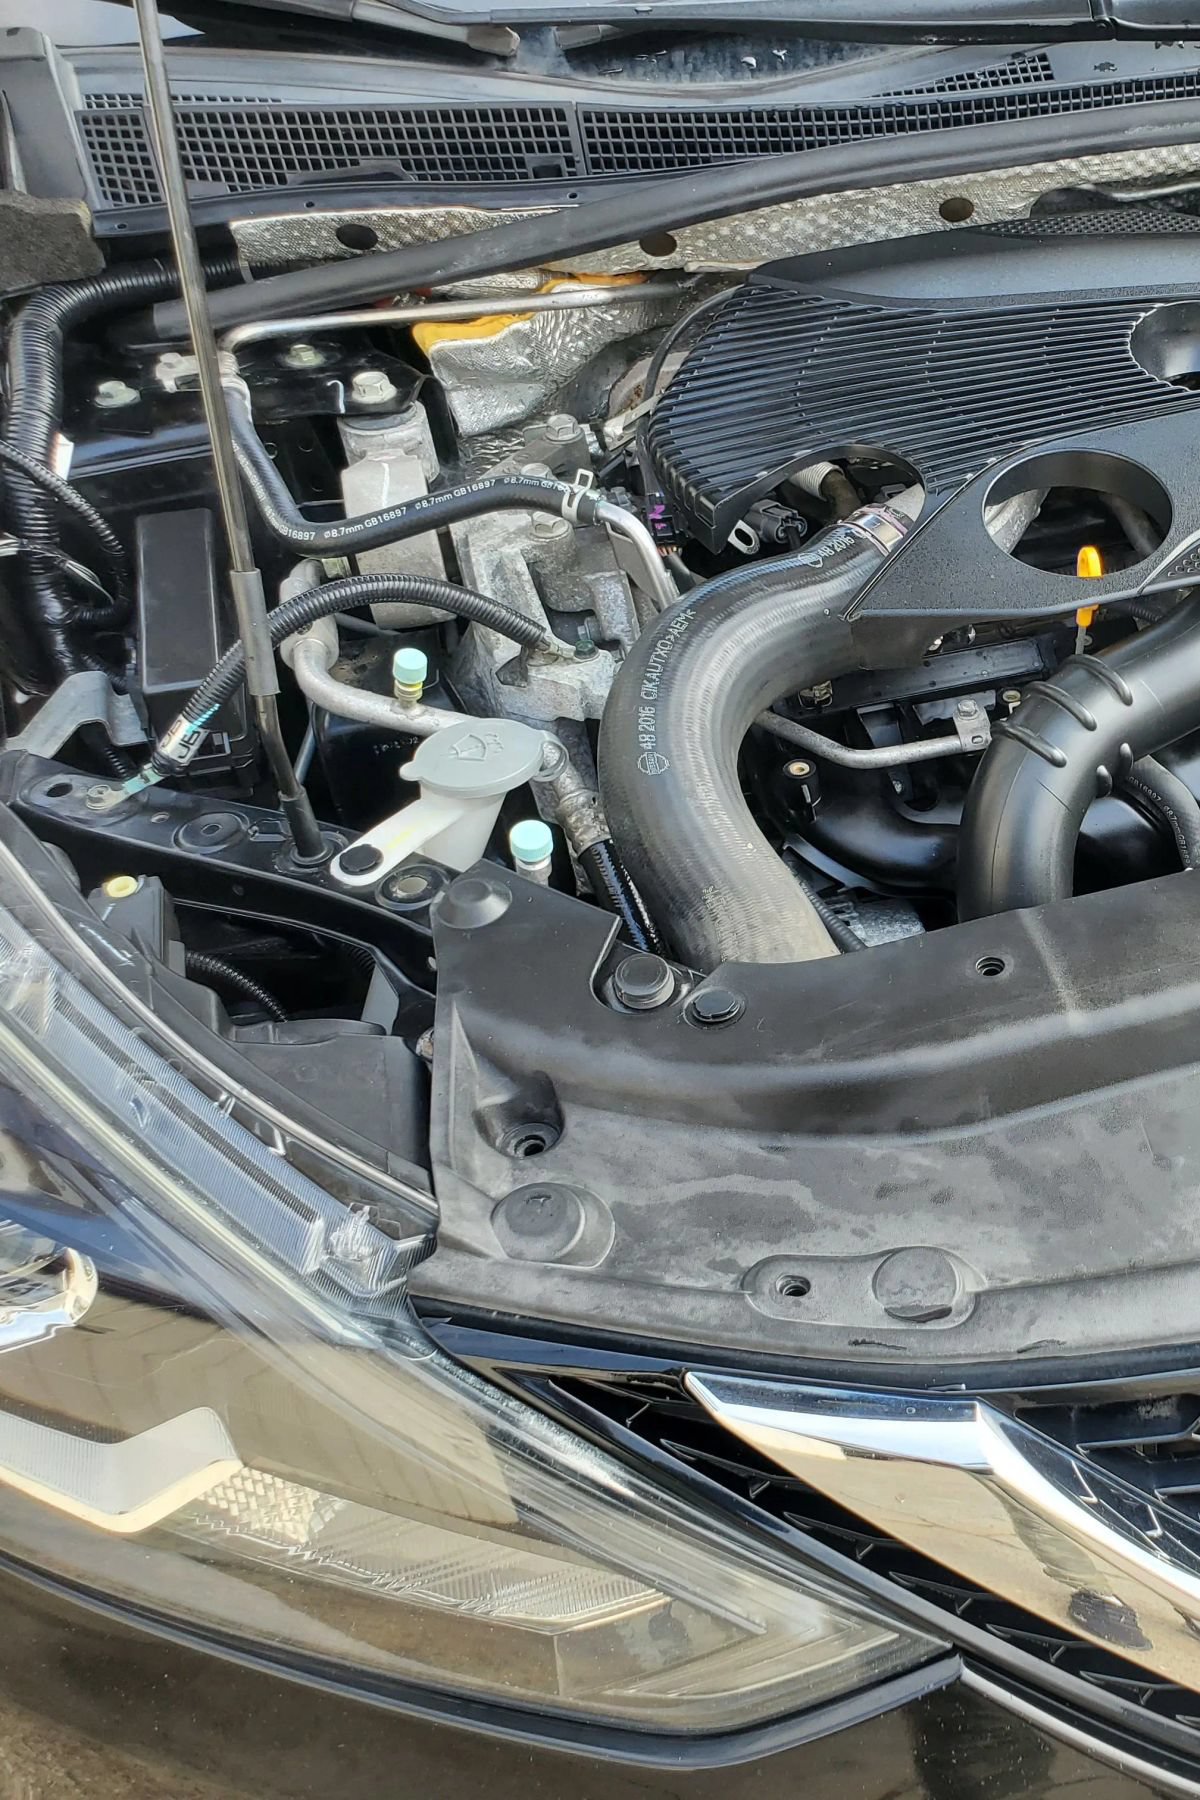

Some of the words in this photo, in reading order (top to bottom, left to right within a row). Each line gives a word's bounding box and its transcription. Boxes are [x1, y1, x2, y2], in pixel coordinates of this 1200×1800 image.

[364, 507, 407, 527] GB16897
[453, 479, 496, 498] GB16897
[638, 706, 656, 731] 2016
[639, 733, 656, 750] 48
